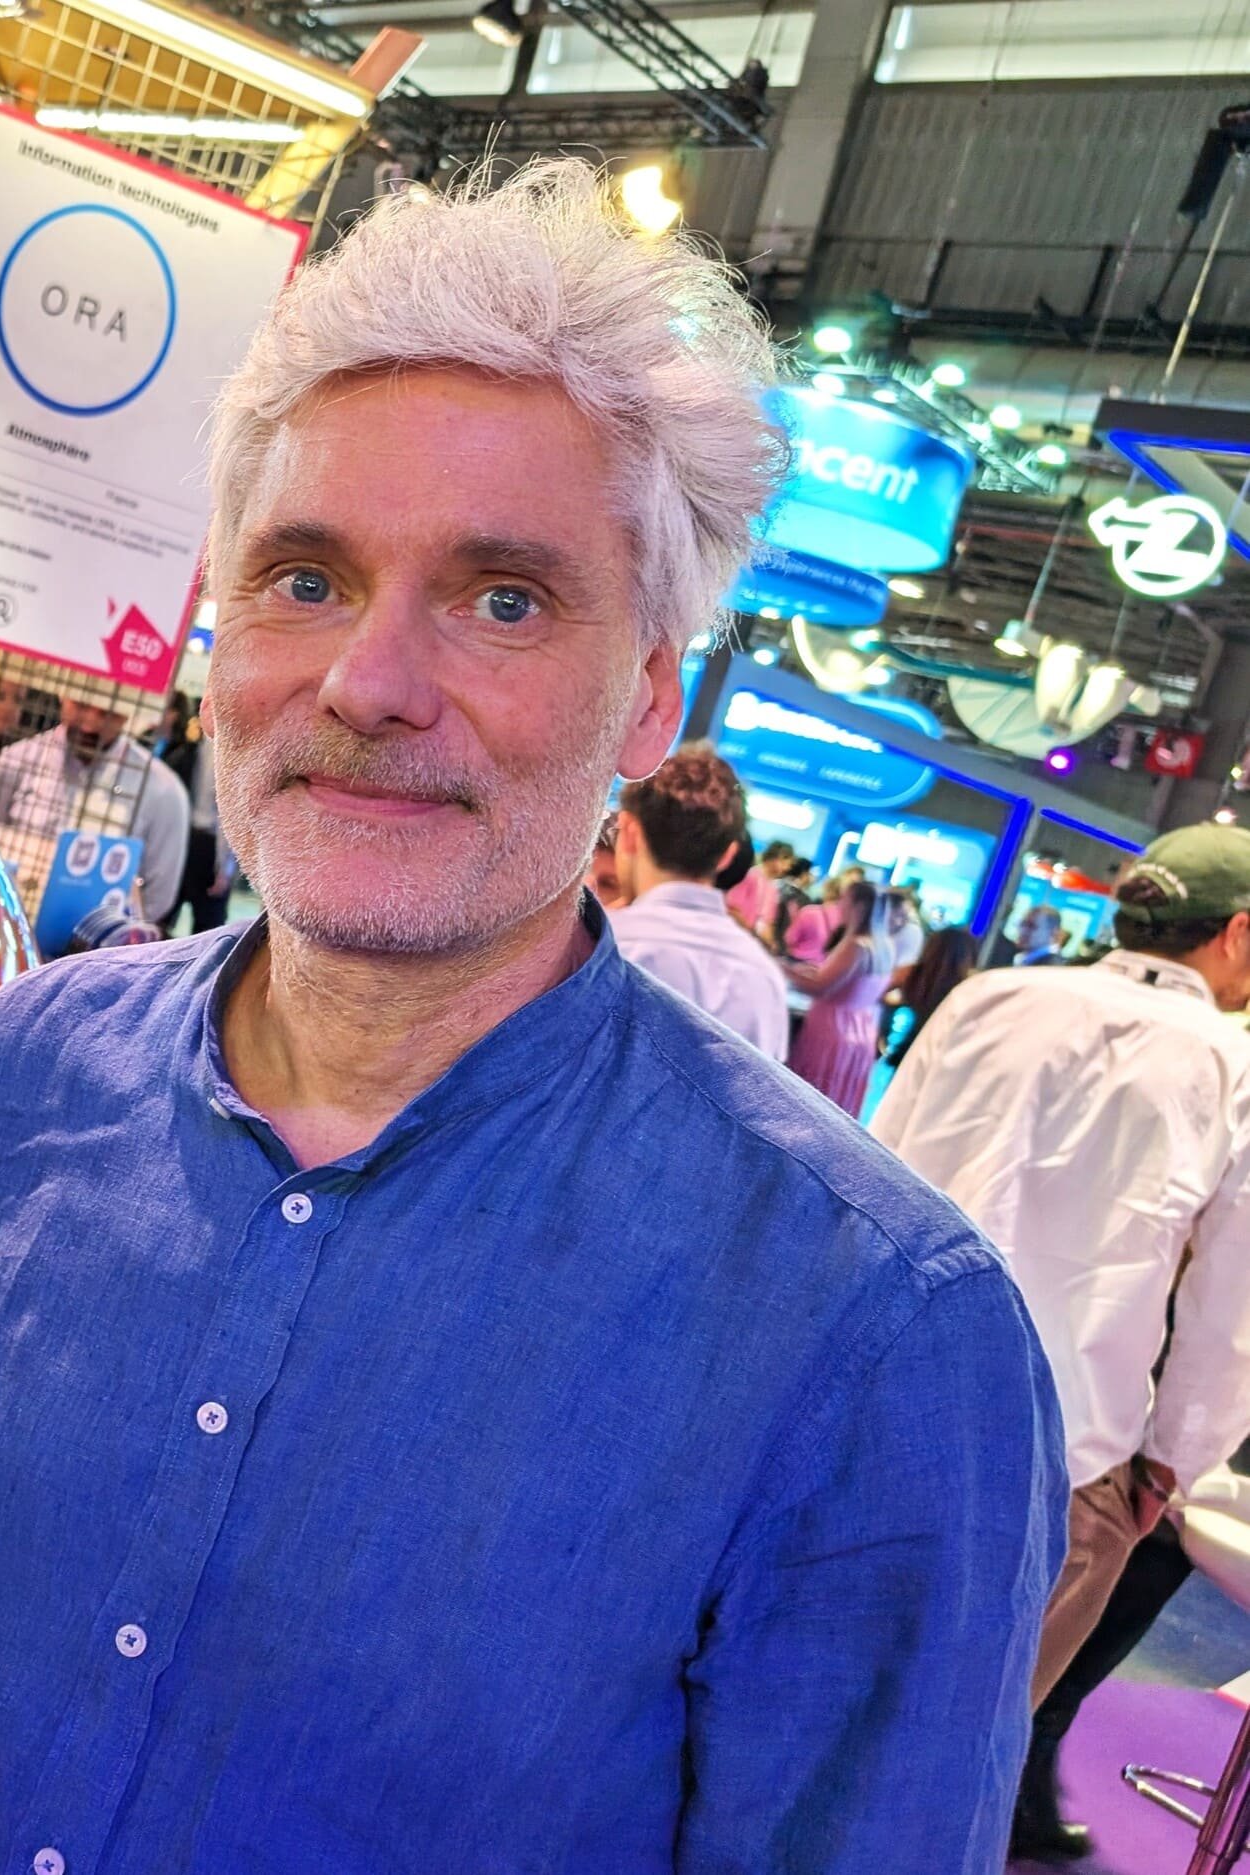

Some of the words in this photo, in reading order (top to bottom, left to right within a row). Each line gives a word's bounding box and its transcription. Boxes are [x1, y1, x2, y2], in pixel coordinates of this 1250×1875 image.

[18, 138, 115, 191] Information
[117, 179, 221, 234] technologies
[40, 283, 127, 342] ORA
